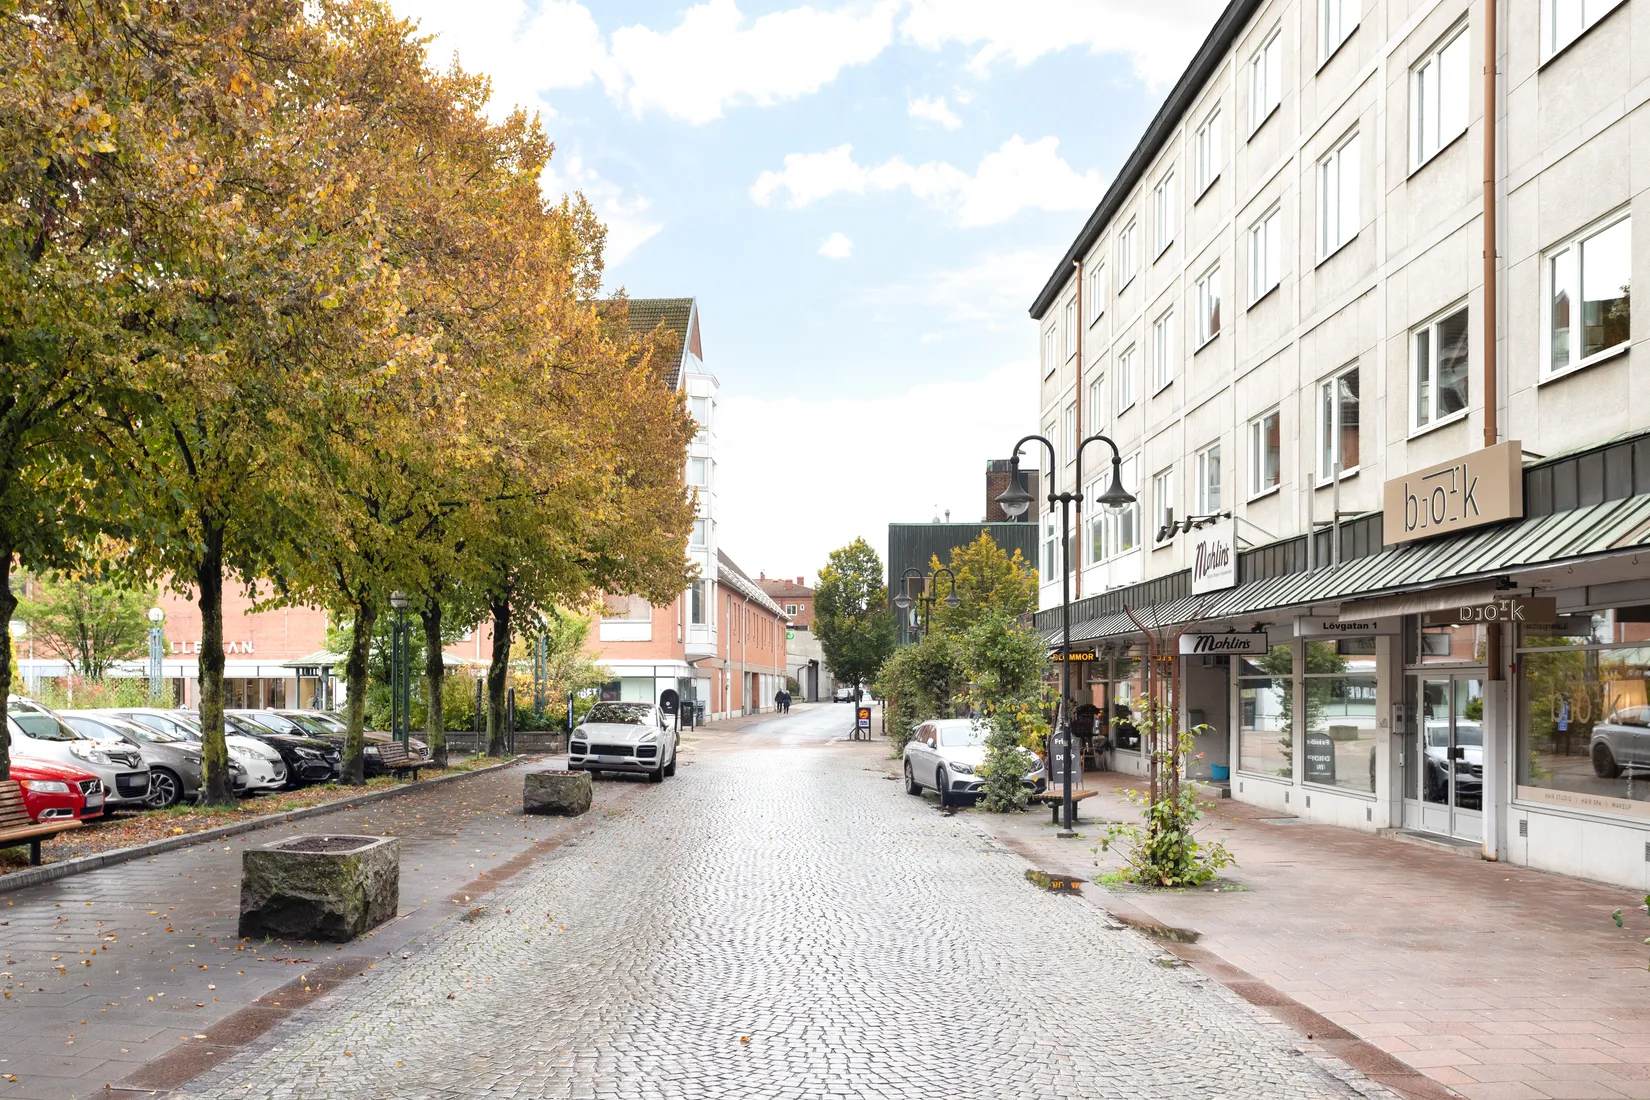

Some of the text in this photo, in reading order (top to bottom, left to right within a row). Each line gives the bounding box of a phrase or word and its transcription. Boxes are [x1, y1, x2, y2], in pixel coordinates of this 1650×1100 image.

[1323, 621, 1378, 632] Lövgatan 1
[1193, 635, 1252, 653] Mohlin's
[1052, 653, 1095, 661] BLMMOR
